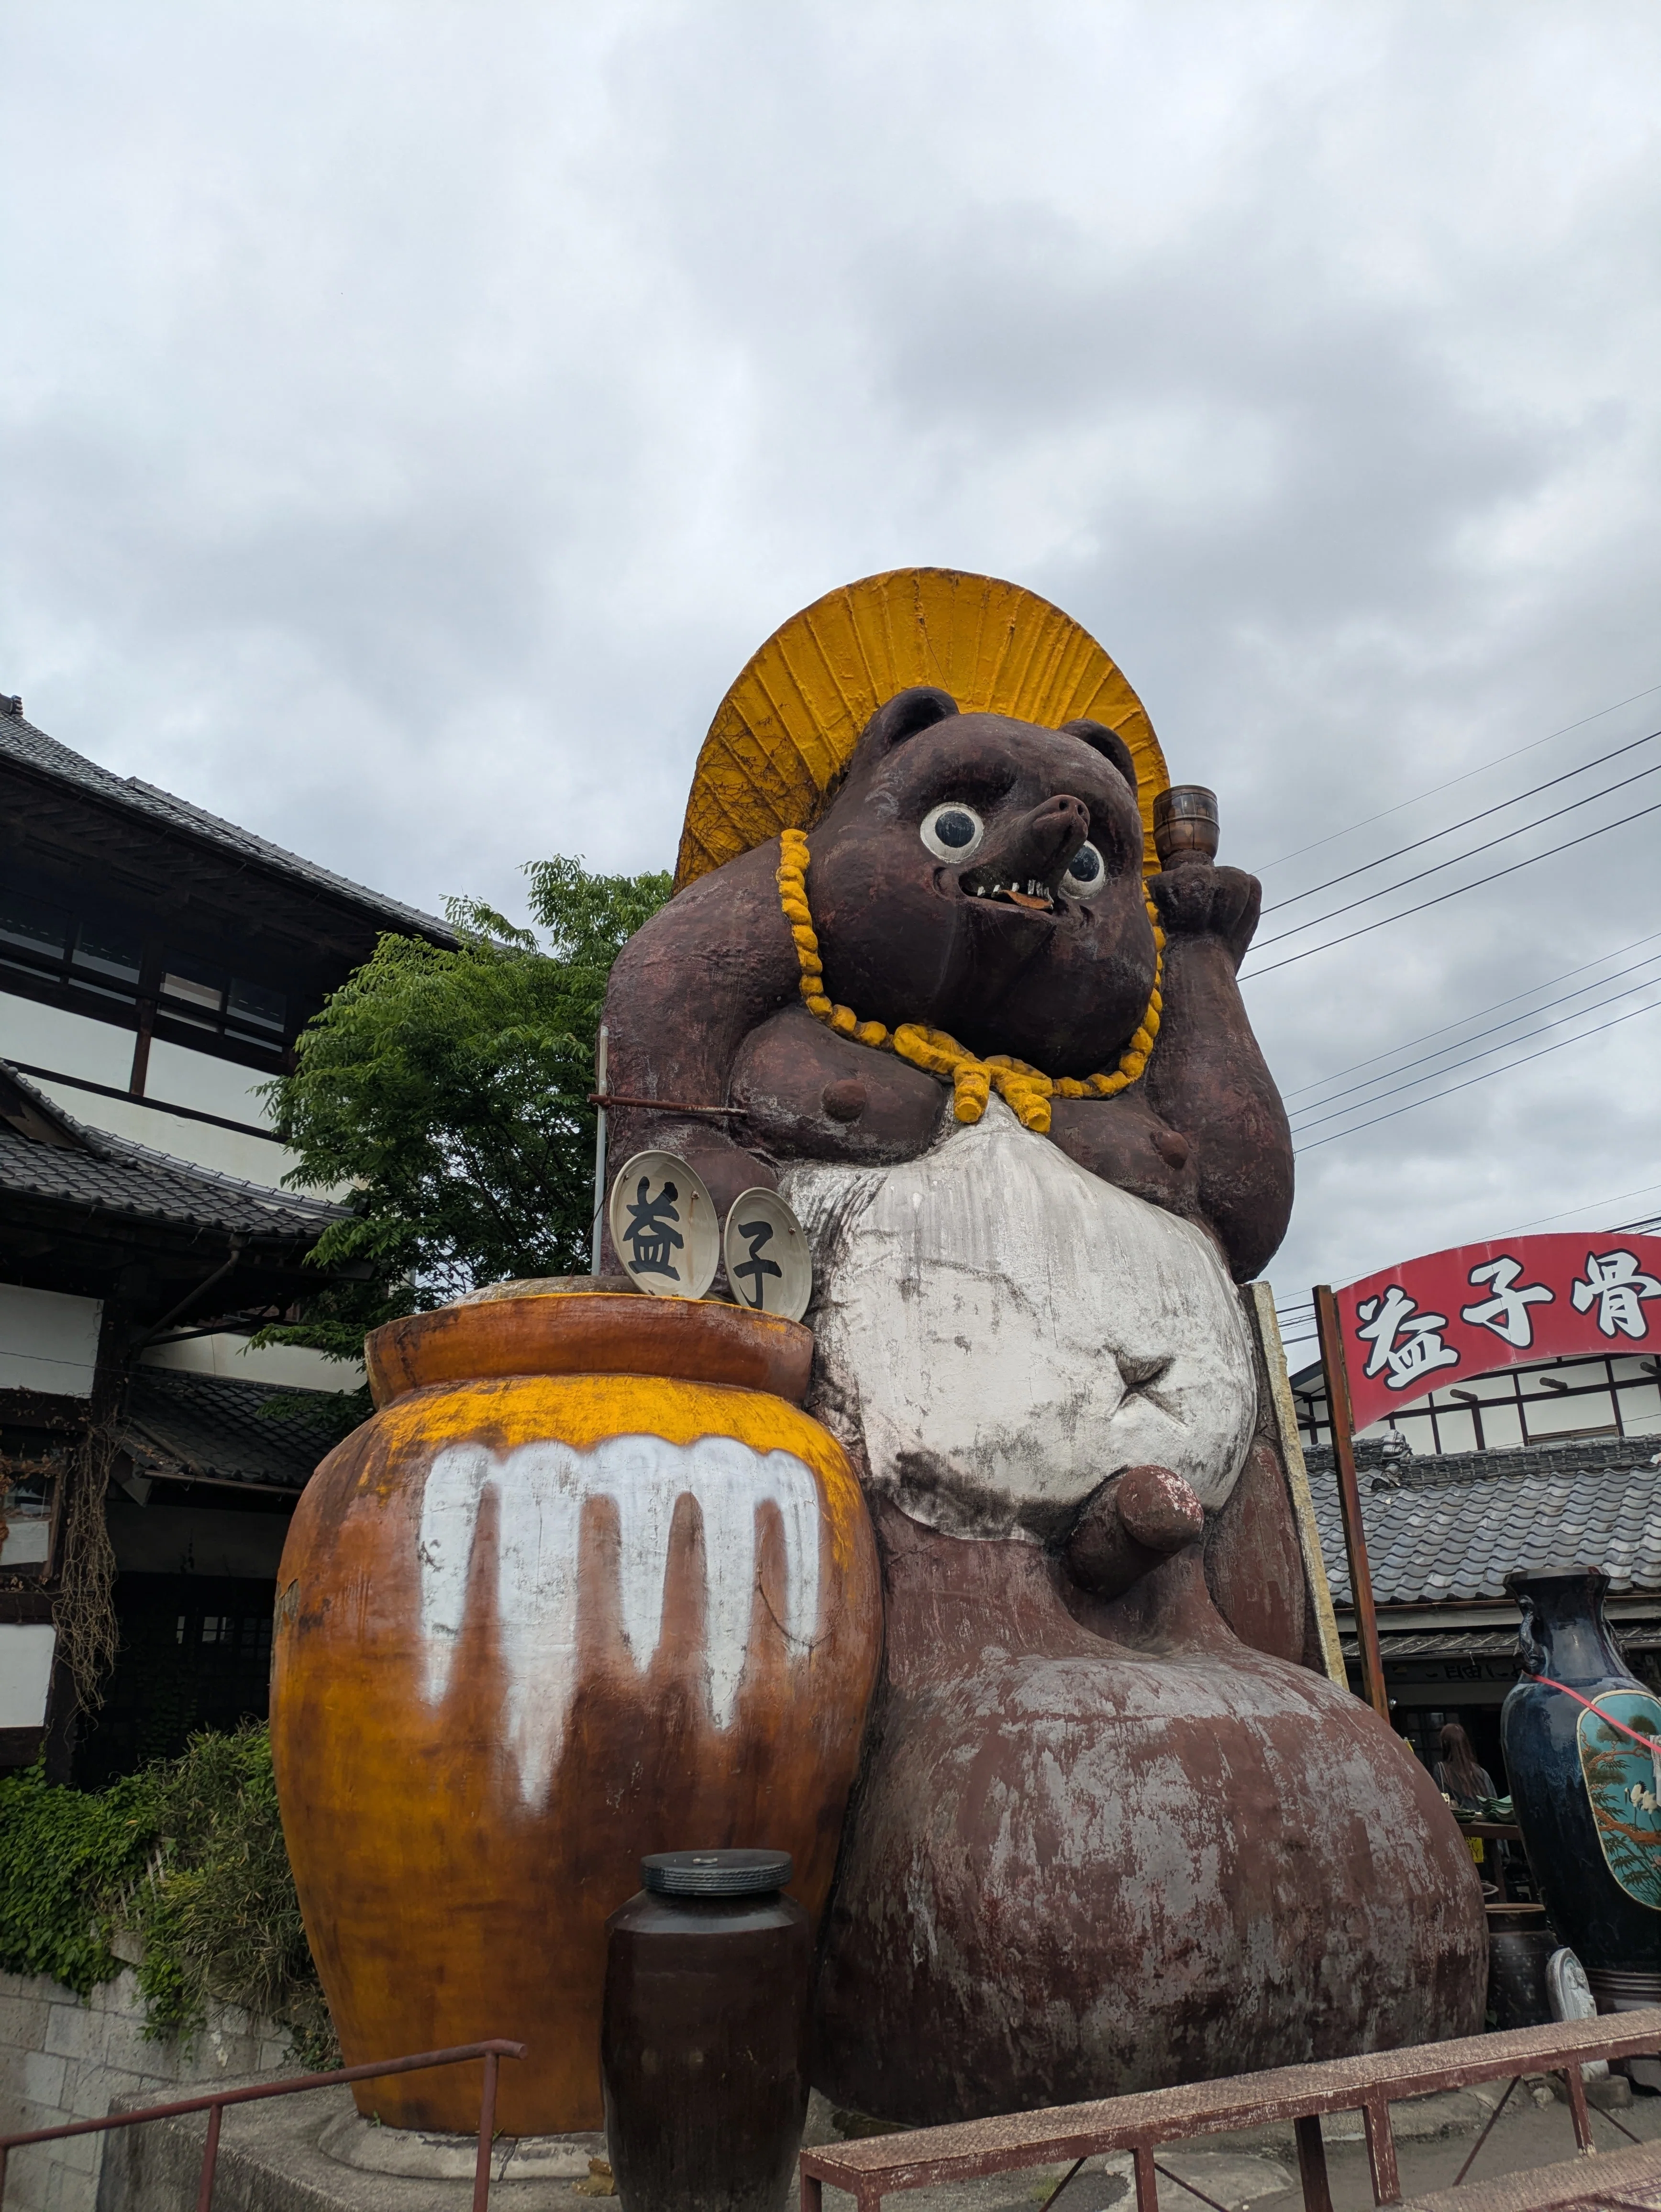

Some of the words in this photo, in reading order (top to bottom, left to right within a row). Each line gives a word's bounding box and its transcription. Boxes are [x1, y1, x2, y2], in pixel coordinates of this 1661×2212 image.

[623, 1176, 684, 1281] 益
[733, 1221, 782, 1310] 子
[1355, 1249, 1661, 1391] 益子骨
